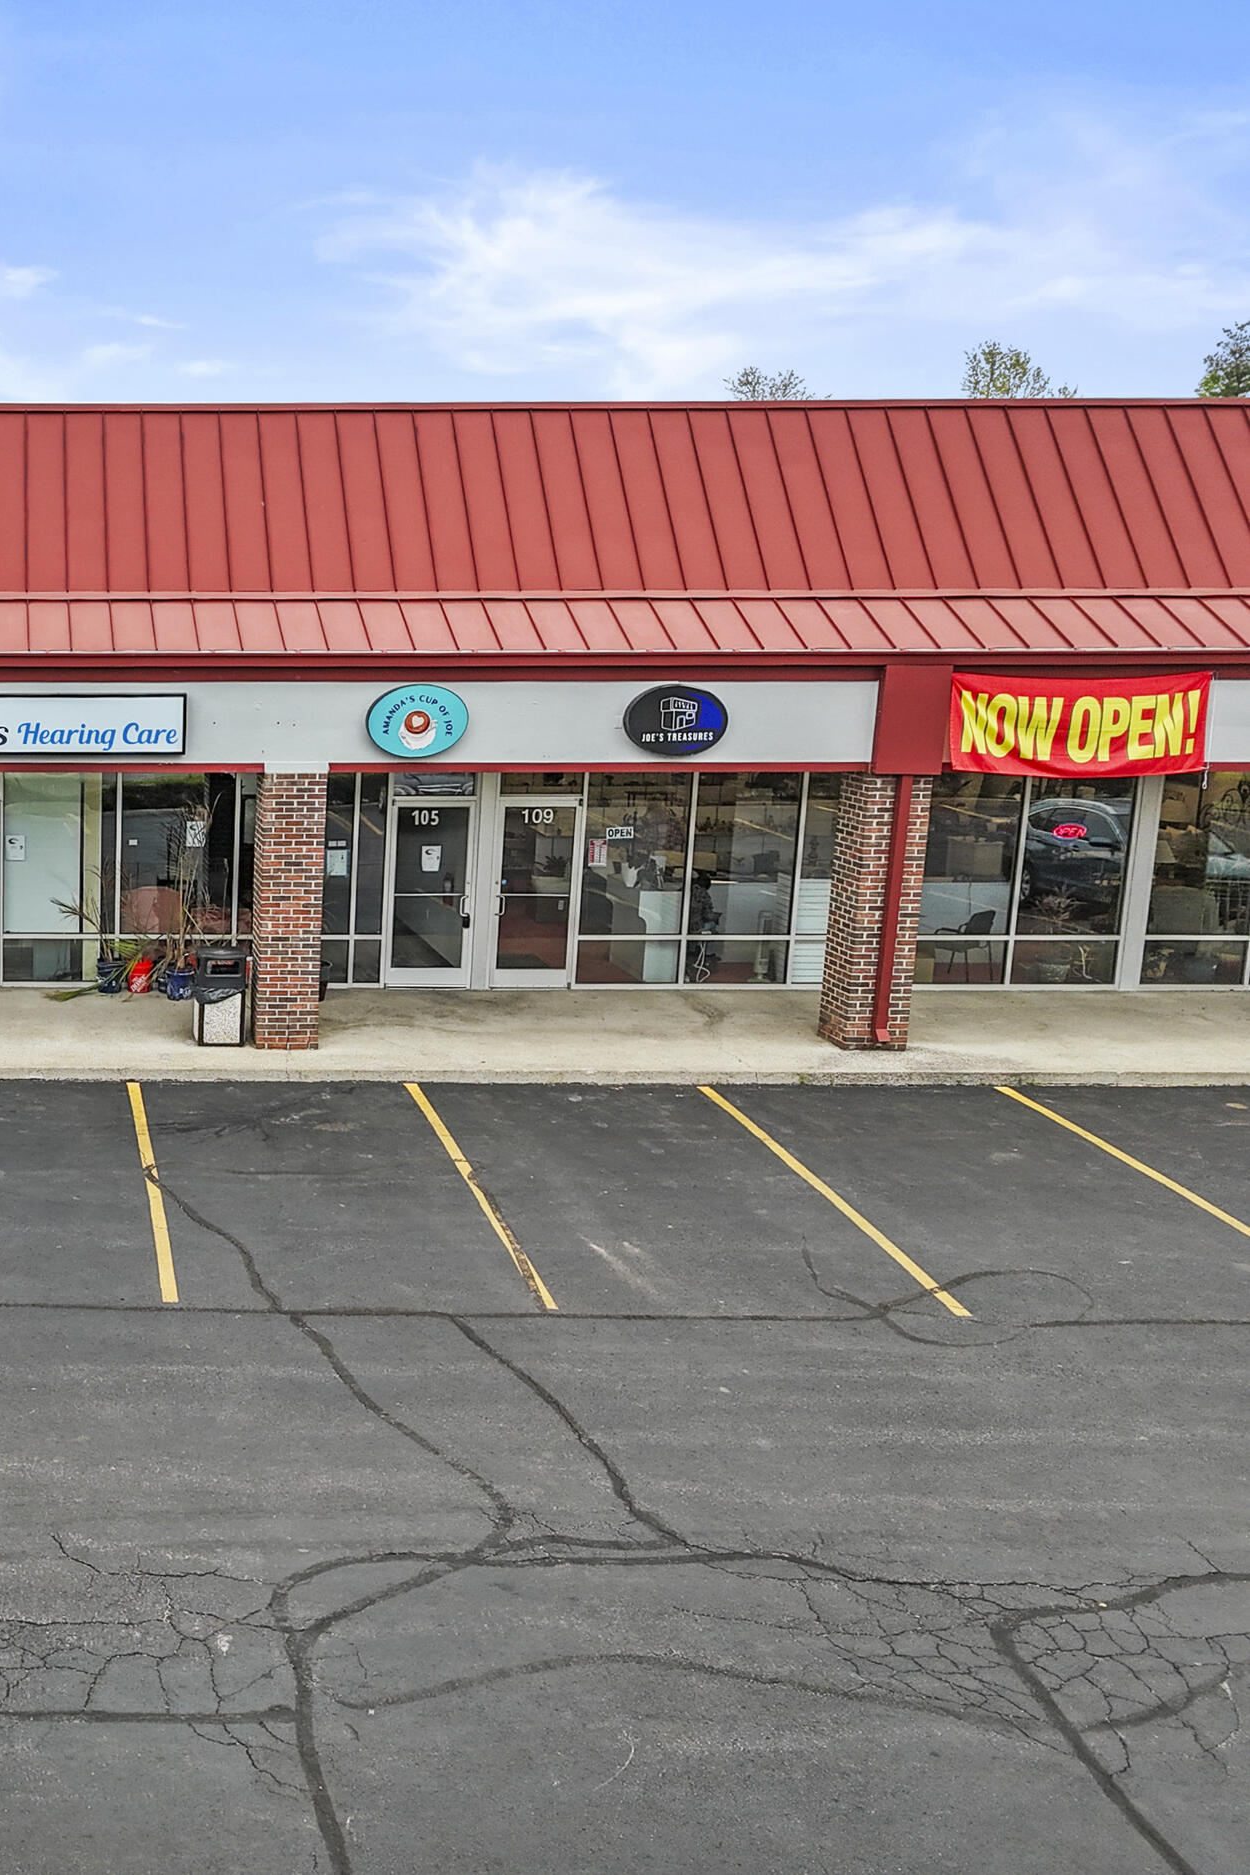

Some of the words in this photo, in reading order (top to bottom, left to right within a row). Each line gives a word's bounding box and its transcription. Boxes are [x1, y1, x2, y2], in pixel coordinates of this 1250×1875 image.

[418, 694, 439, 706] CUP
[382, 694, 416, 735] AMANDA'S
[438, 705, 450, 717] OF
[443, 720, 454, 737] JOE
[960, 690, 1065, 761] NOW
[1066, 689, 1201, 764] OPEN!
[17, 722, 117, 751] Hearing
[122, 722, 179, 745] Care
[641, 732, 664, 743] JOE'S
[667, 731, 714, 742] TREASURES
[411, 809, 440, 826] 105
[521, 808, 554, 824] 109
[607, 828, 633, 838] OPEN
[1056, 827, 1086, 838] OPEN
